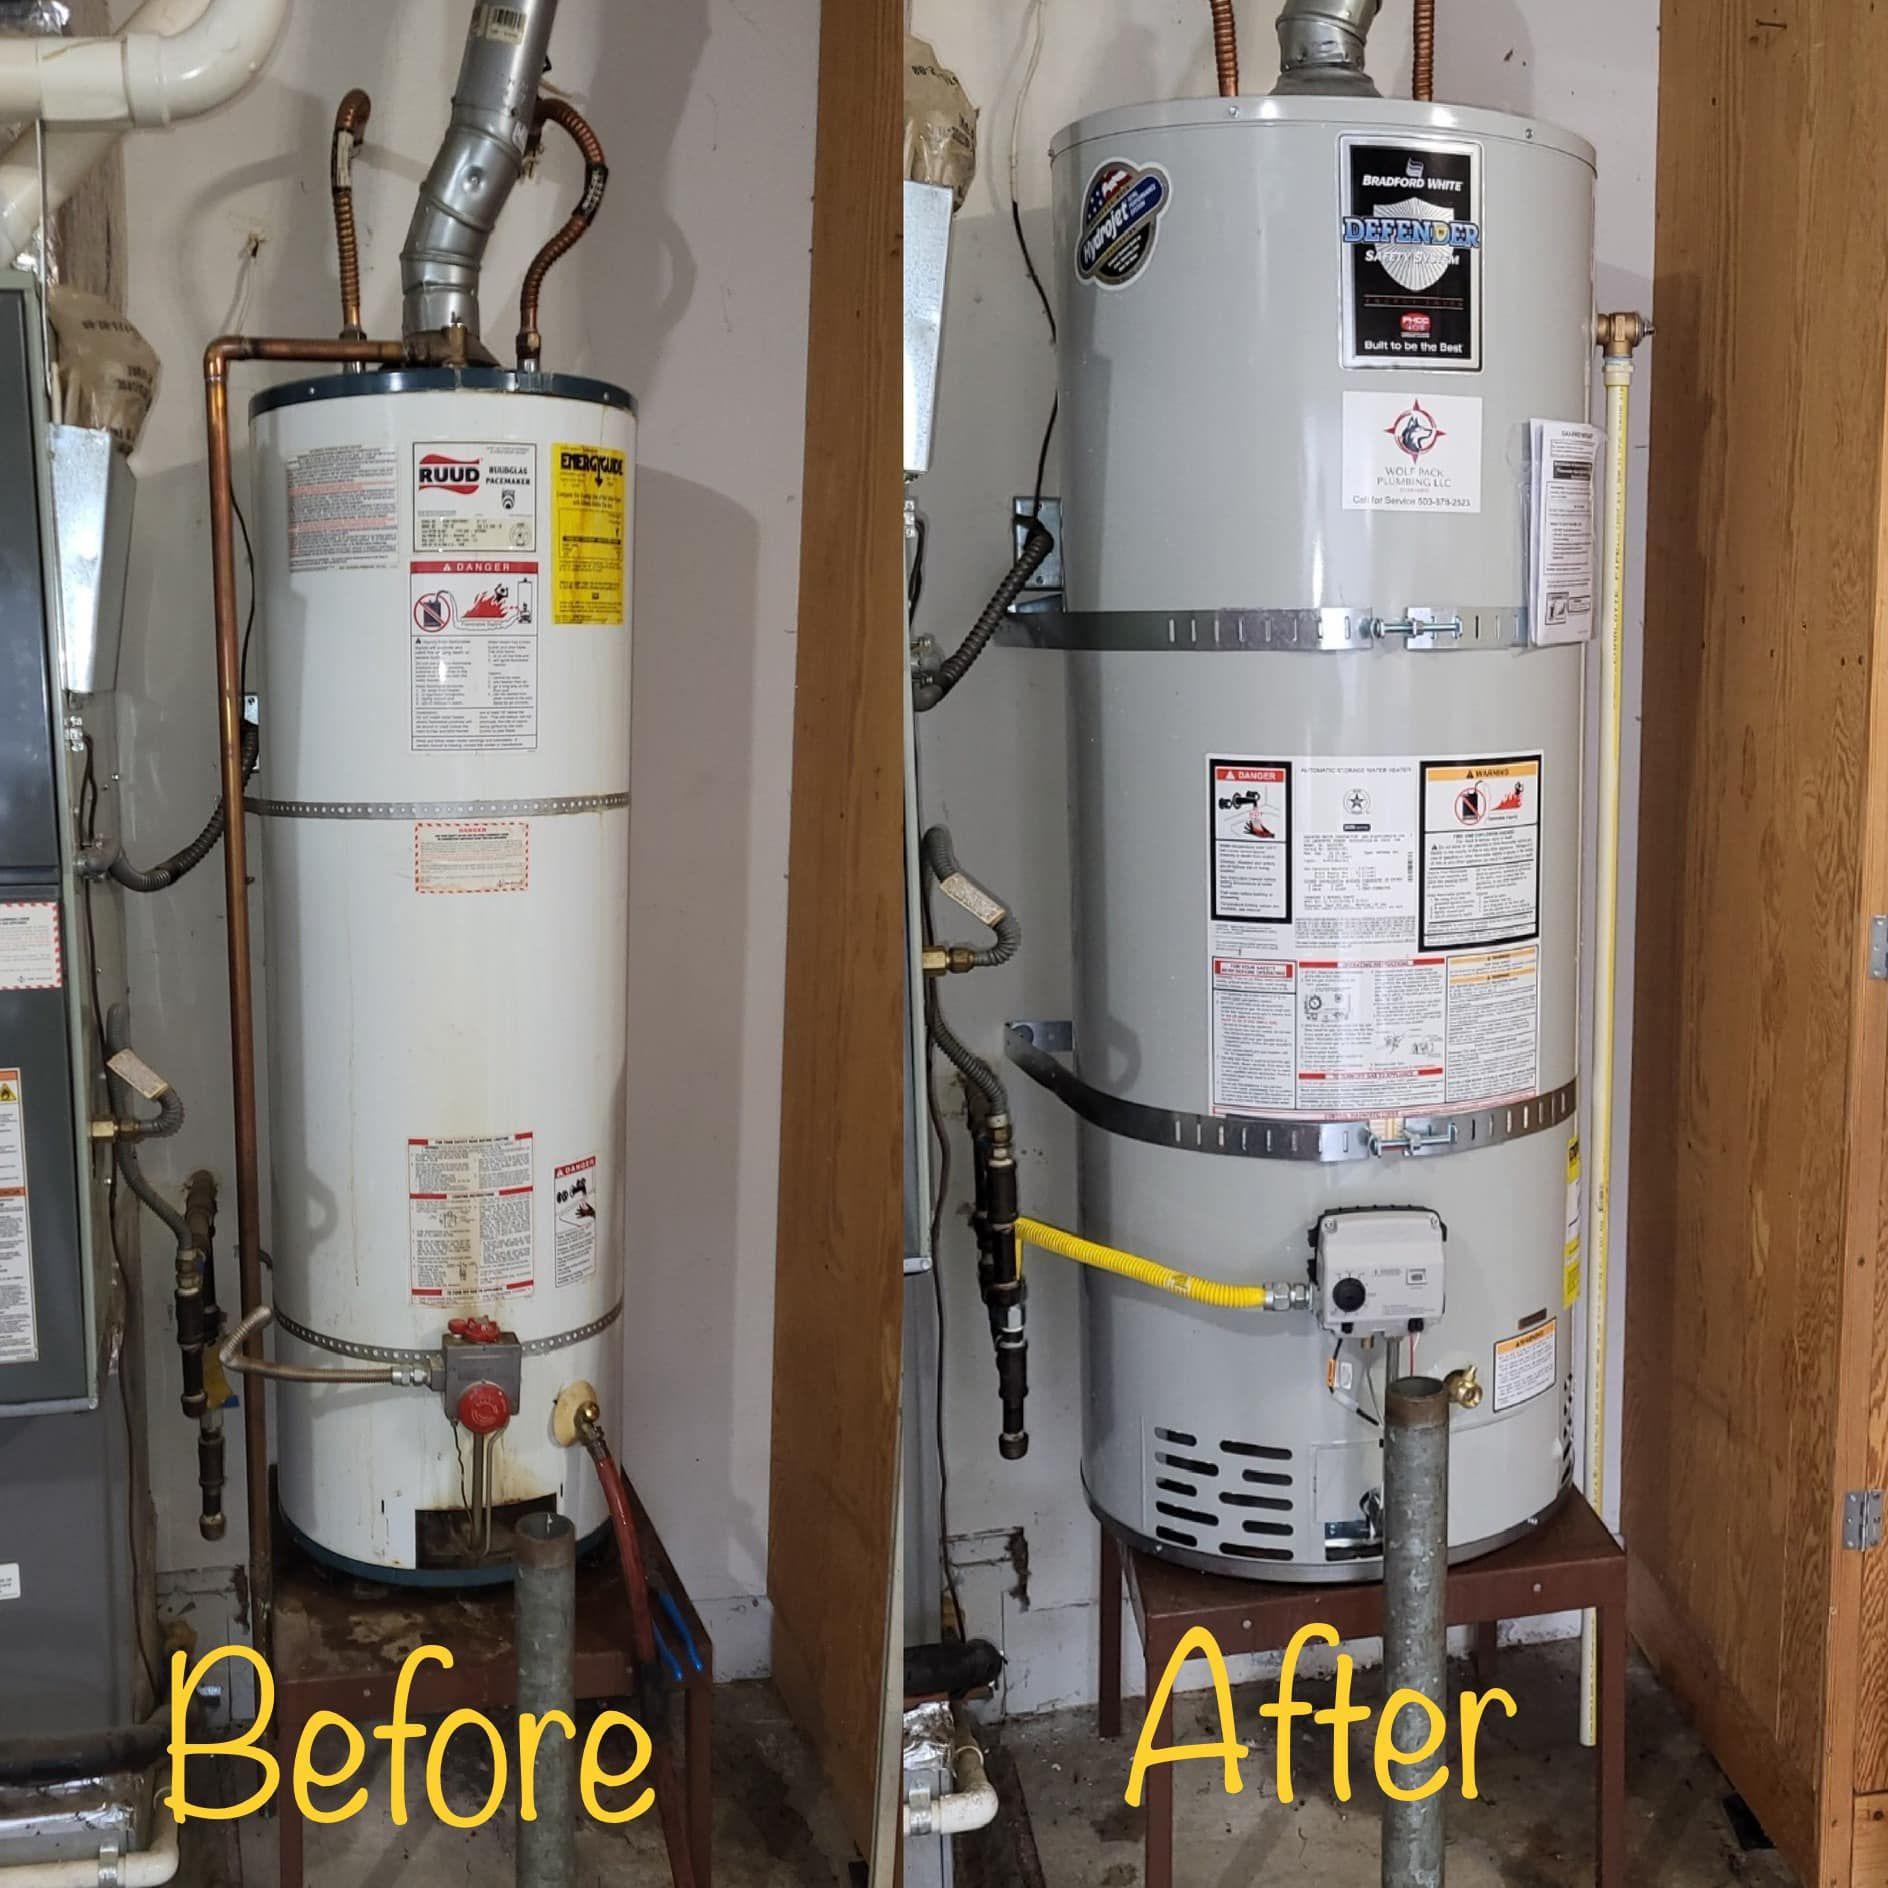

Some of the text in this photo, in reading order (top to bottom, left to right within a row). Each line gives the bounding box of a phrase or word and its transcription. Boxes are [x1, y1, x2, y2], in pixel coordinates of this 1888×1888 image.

[1362, 175, 1463, 192] BRADFORD WHITE
[1083, 200, 1129, 264] Hydrojet
[1343, 216, 1480, 248] DEFENDER
[1365, 250, 1411, 262] SAFETY
[1364, 341, 1463, 353] Built to be the Best
[419, 467, 480, 483] RUUD
[1385, 467, 1444, 477] WOLF PACK
[1377, 477, 1452, 487] PLUMBING LLC
[456, 563, 511, 571] DANGER
[1238, 771, 1276, 780] DANGER
